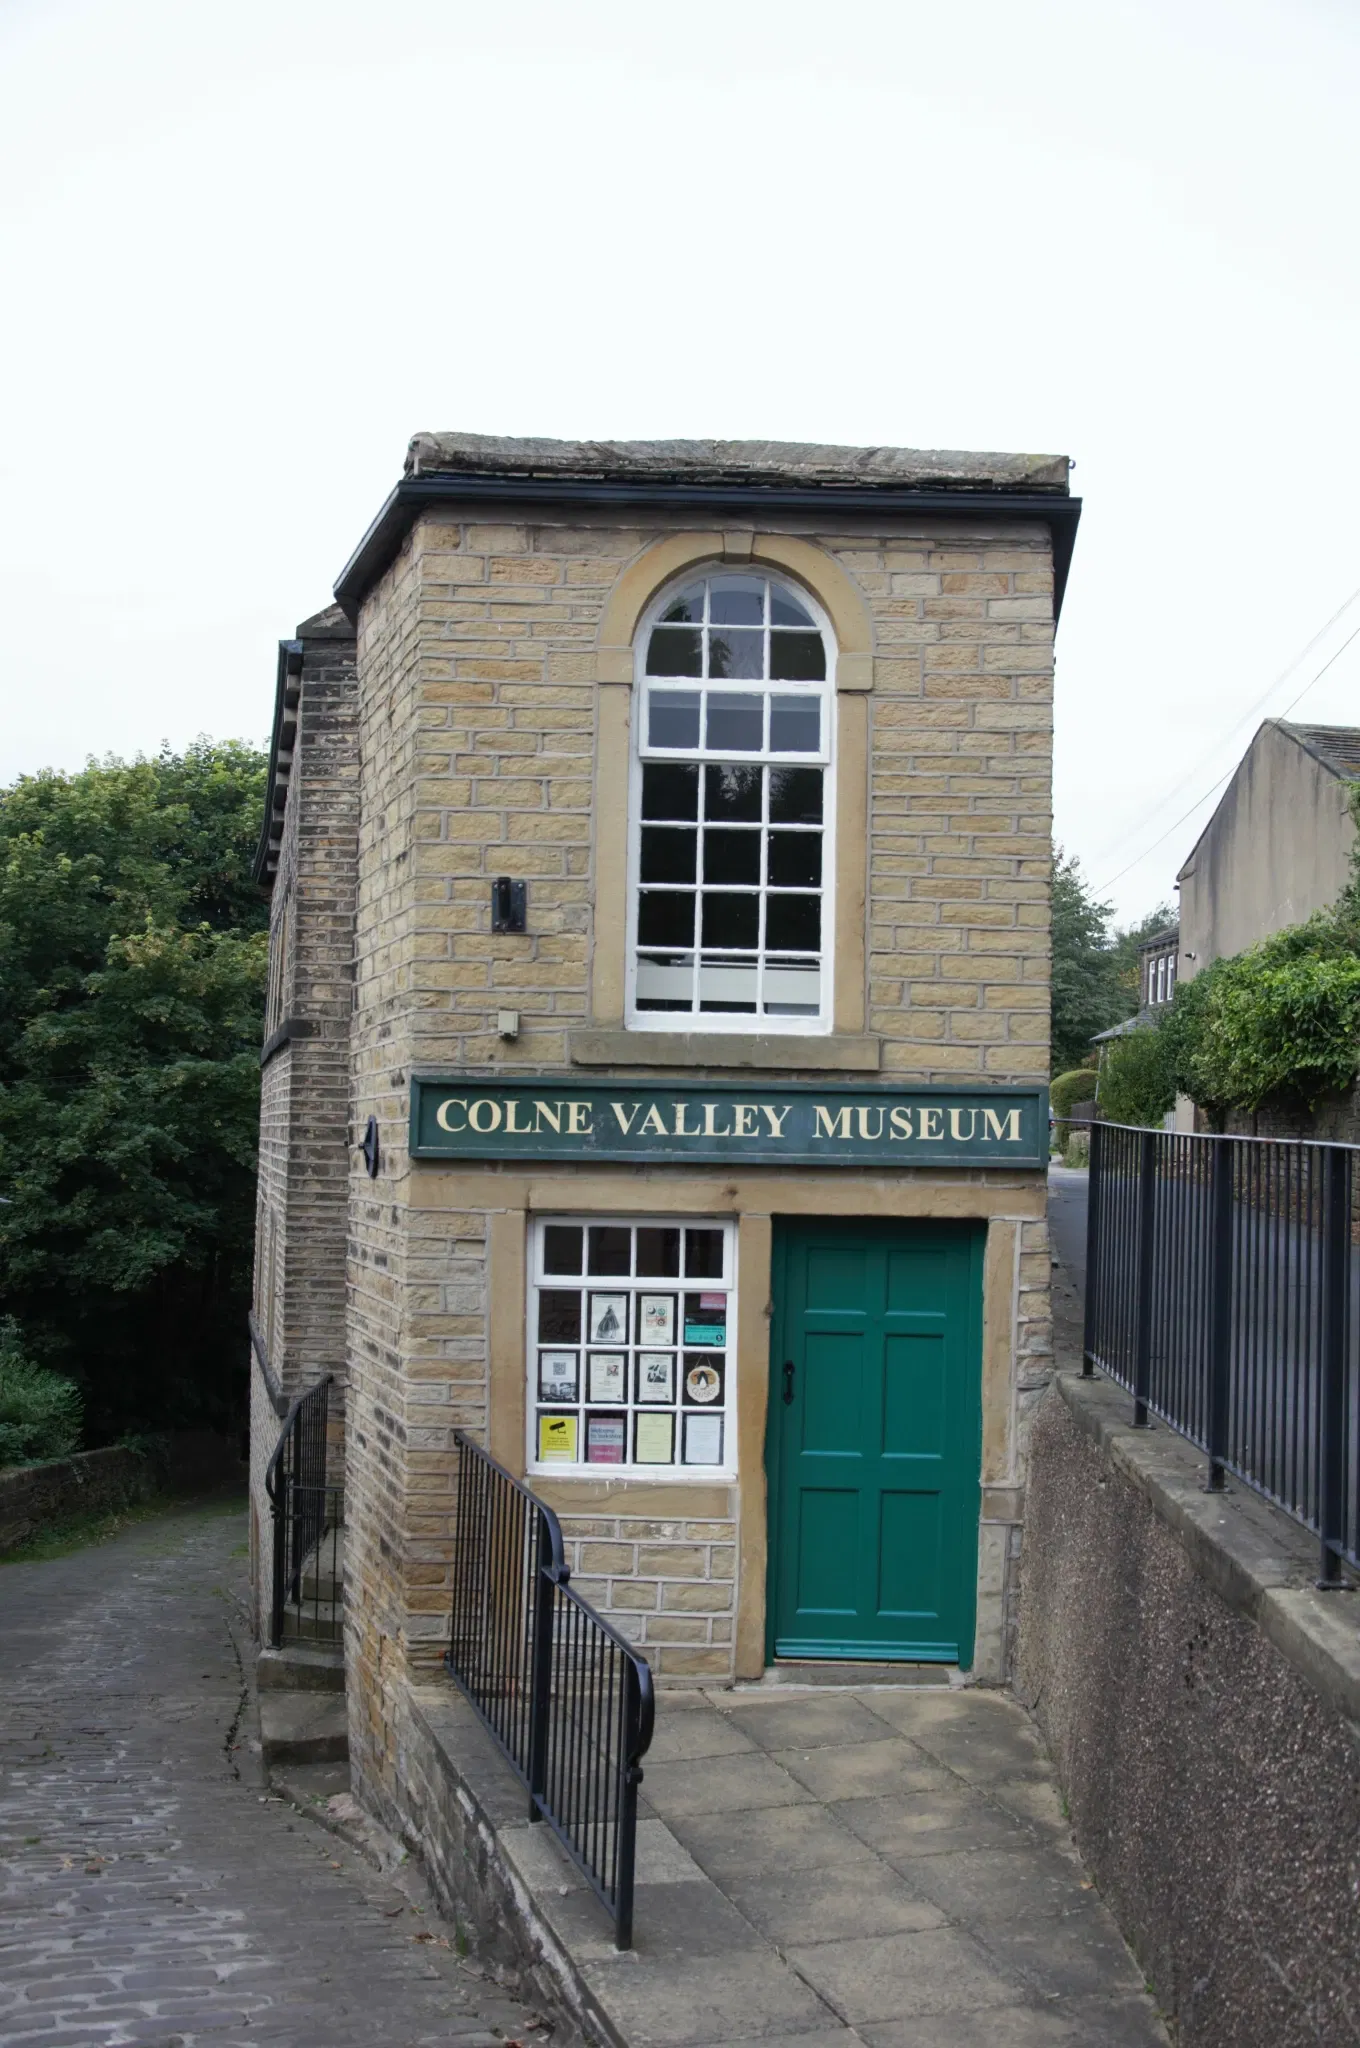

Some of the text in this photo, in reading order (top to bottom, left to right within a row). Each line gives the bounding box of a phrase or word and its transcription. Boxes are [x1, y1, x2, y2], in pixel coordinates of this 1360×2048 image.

[436, 1099, 1022, 1141] COLNE VALLEY MUSEUM
